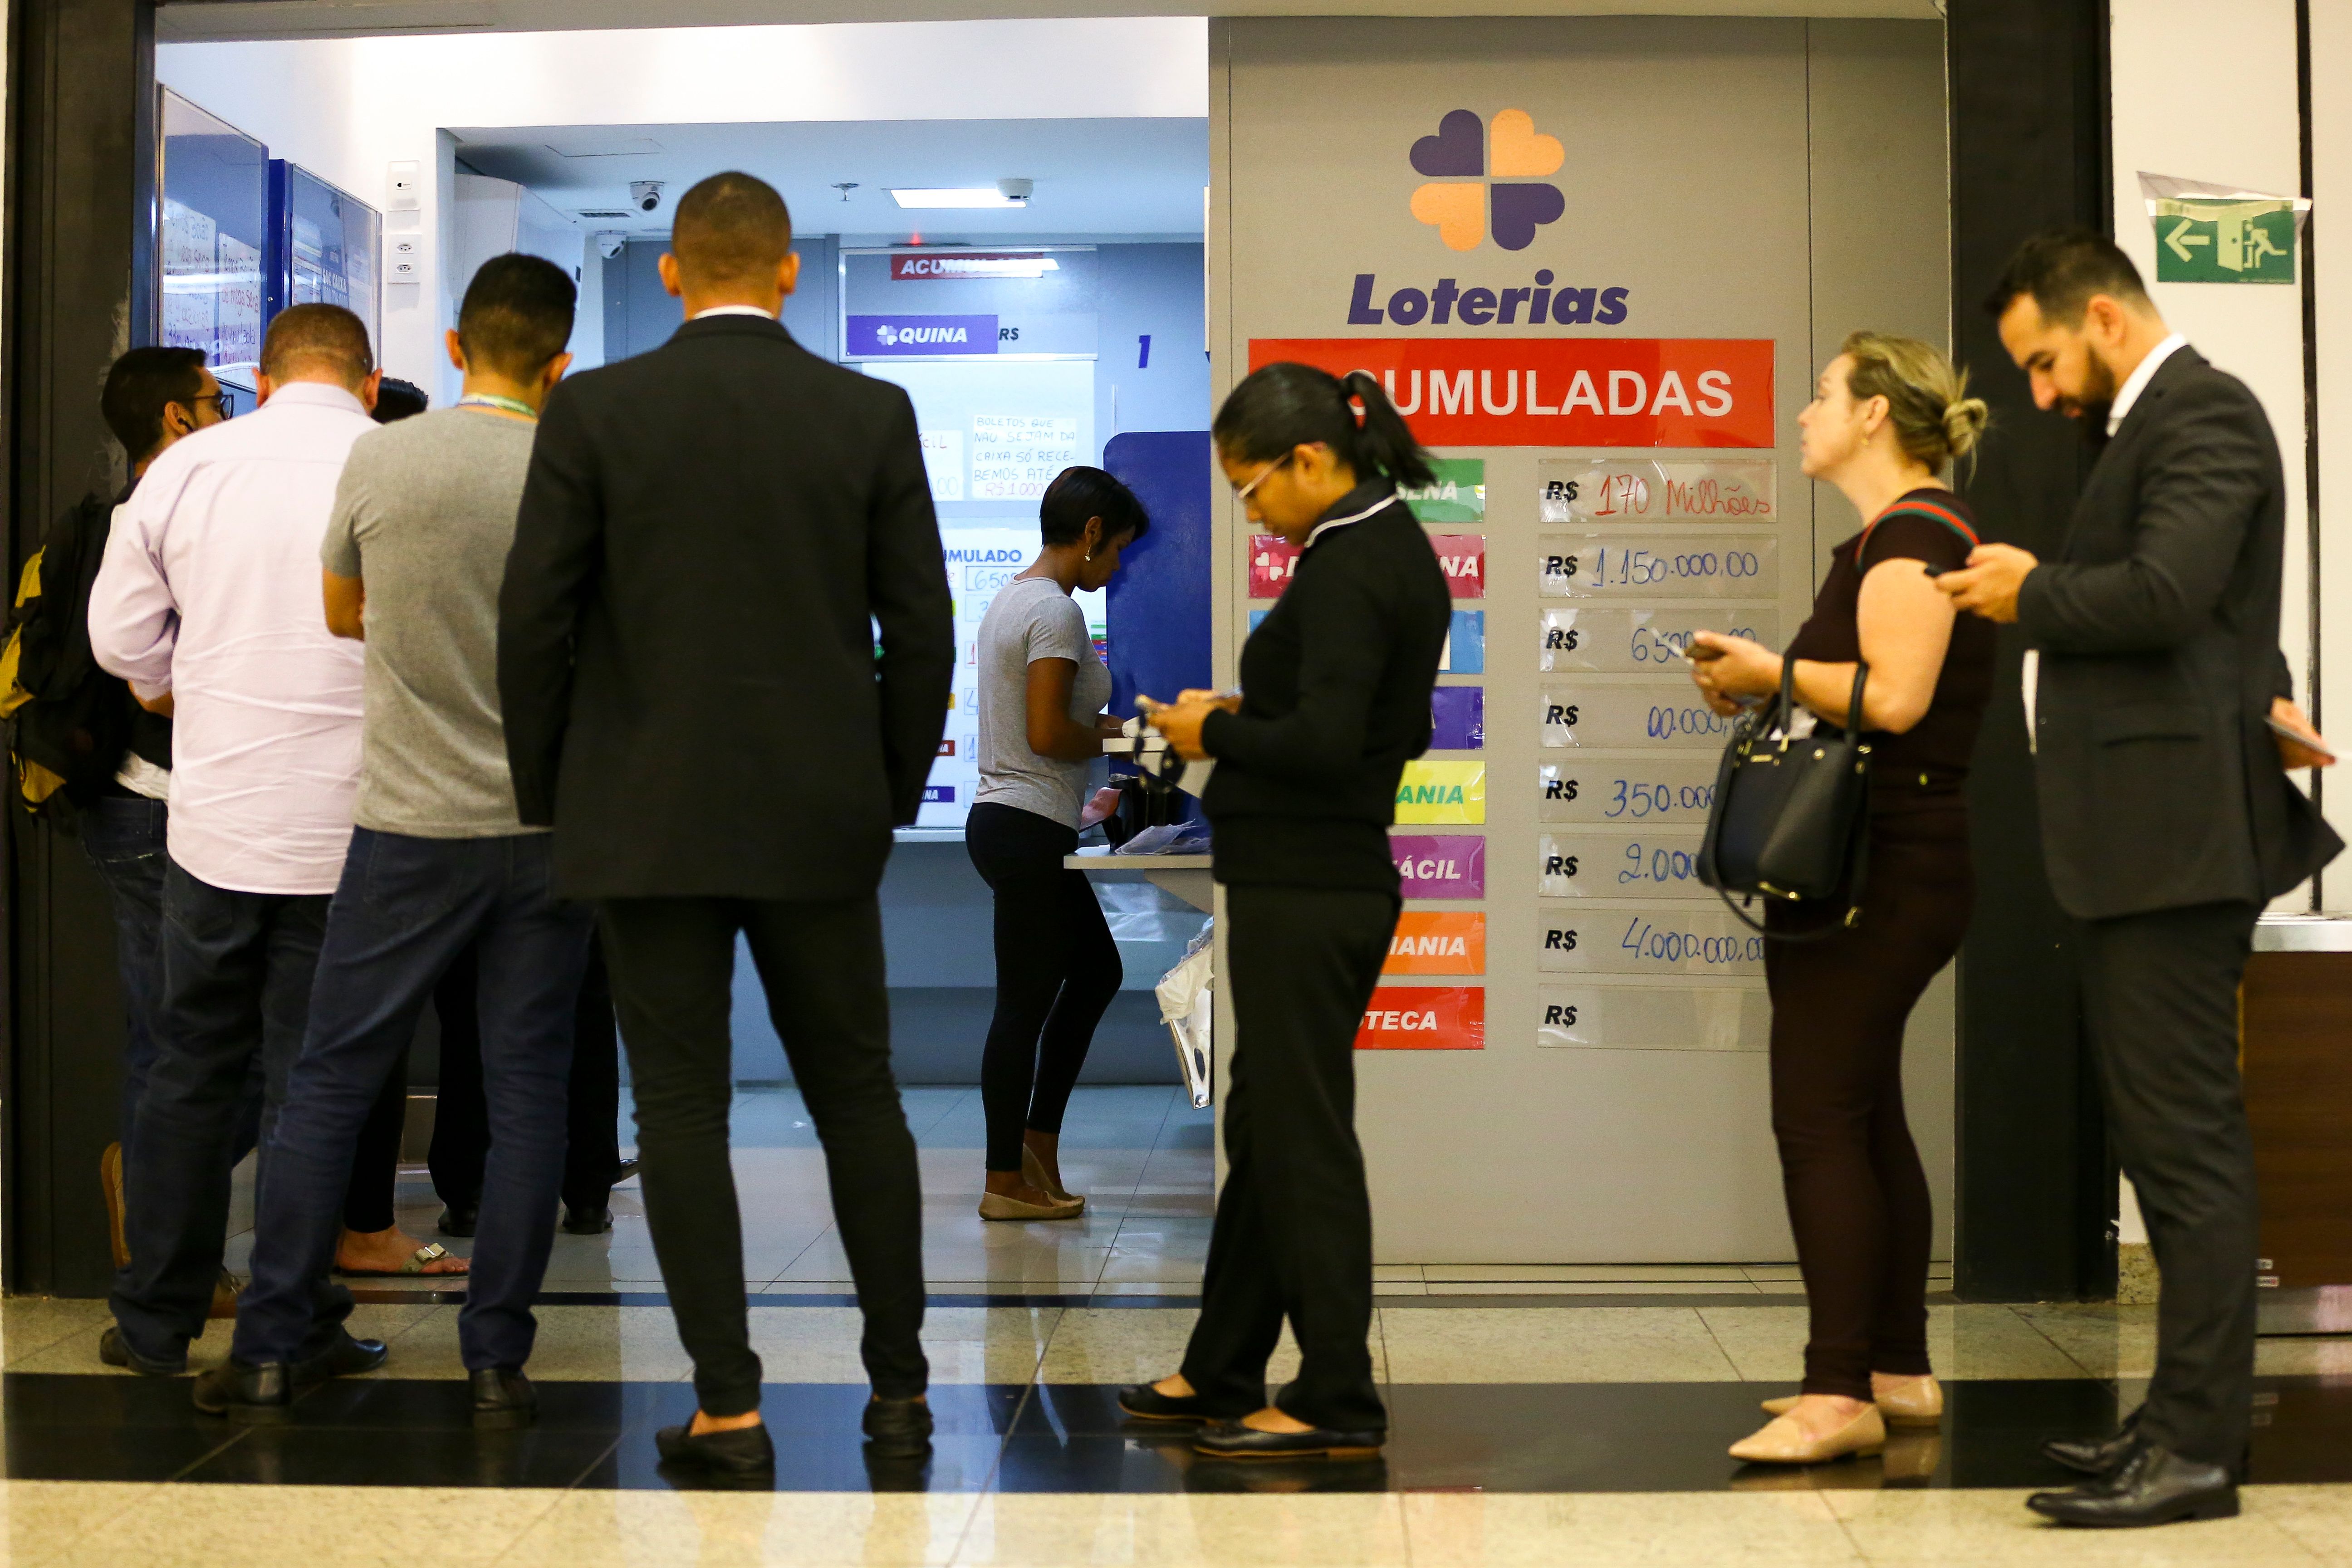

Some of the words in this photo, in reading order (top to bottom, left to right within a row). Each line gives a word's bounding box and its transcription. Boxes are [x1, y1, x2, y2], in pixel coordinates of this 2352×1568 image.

[1347, 269, 1630, 326] Loterias
[899, 327, 968, 345] QUINA
[1138, 335, 1151, 368] 1
[1344, 369, 1733, 417] UMULADAS
[977, 417, 1025, 427] BOLETOS
[1031, 419, 1054, 427] QUE
[1007, 431, 1054, 443] SEJAM
[1060, 431, 1075, 441] DA
[976, 451, 1010, 462] CAIXA
[1016, 449, 1034, 463] SÓ
[974, 468, 1019, 482] BEMOS
[1027, 465, 1054, 480] ATÉ
[1546, 480, 1579, 502] R$
[1594, 474, 1650, 516] 170
[1666, 479, 1771, 516] Milhões
[1545, 555, 1578, 578] R$
[1592, 548, 1759, 587] 1.150.000,00
[1546, 629, 1578, 652] R$
[1546, 705, 1579, 728] R$
[1545, 779, 1579, 802] R$
[1393, 855, 1461, 880] ÁCIL
[1545, 855, 1579, 878] R$
[1545, 929, 1578, 952] R$
[1359, 1011, 1438, 1031] TECA
[1544, 1004, 1578, 1028] R$
